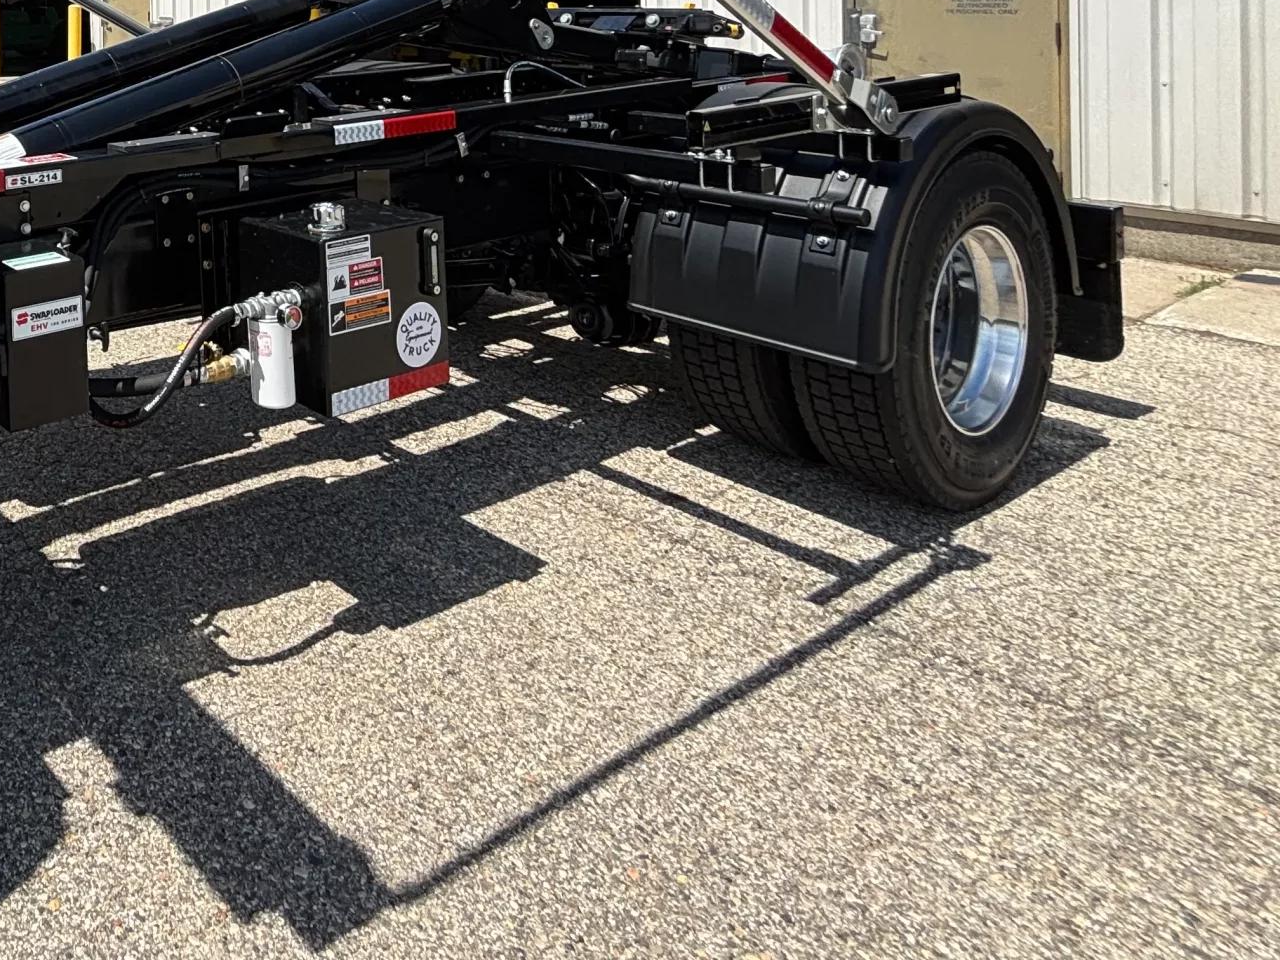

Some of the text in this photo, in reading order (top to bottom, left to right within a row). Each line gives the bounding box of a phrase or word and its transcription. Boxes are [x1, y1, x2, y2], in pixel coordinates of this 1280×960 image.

[20, 172, 58, 185] SL-214
[30, 304, 79, 321] SWAPLOADER
[31, 322, 49, 332] EHV
[400, 311, 437, 333] QUALITY
[403, 336, 436, 356] TRUCK
